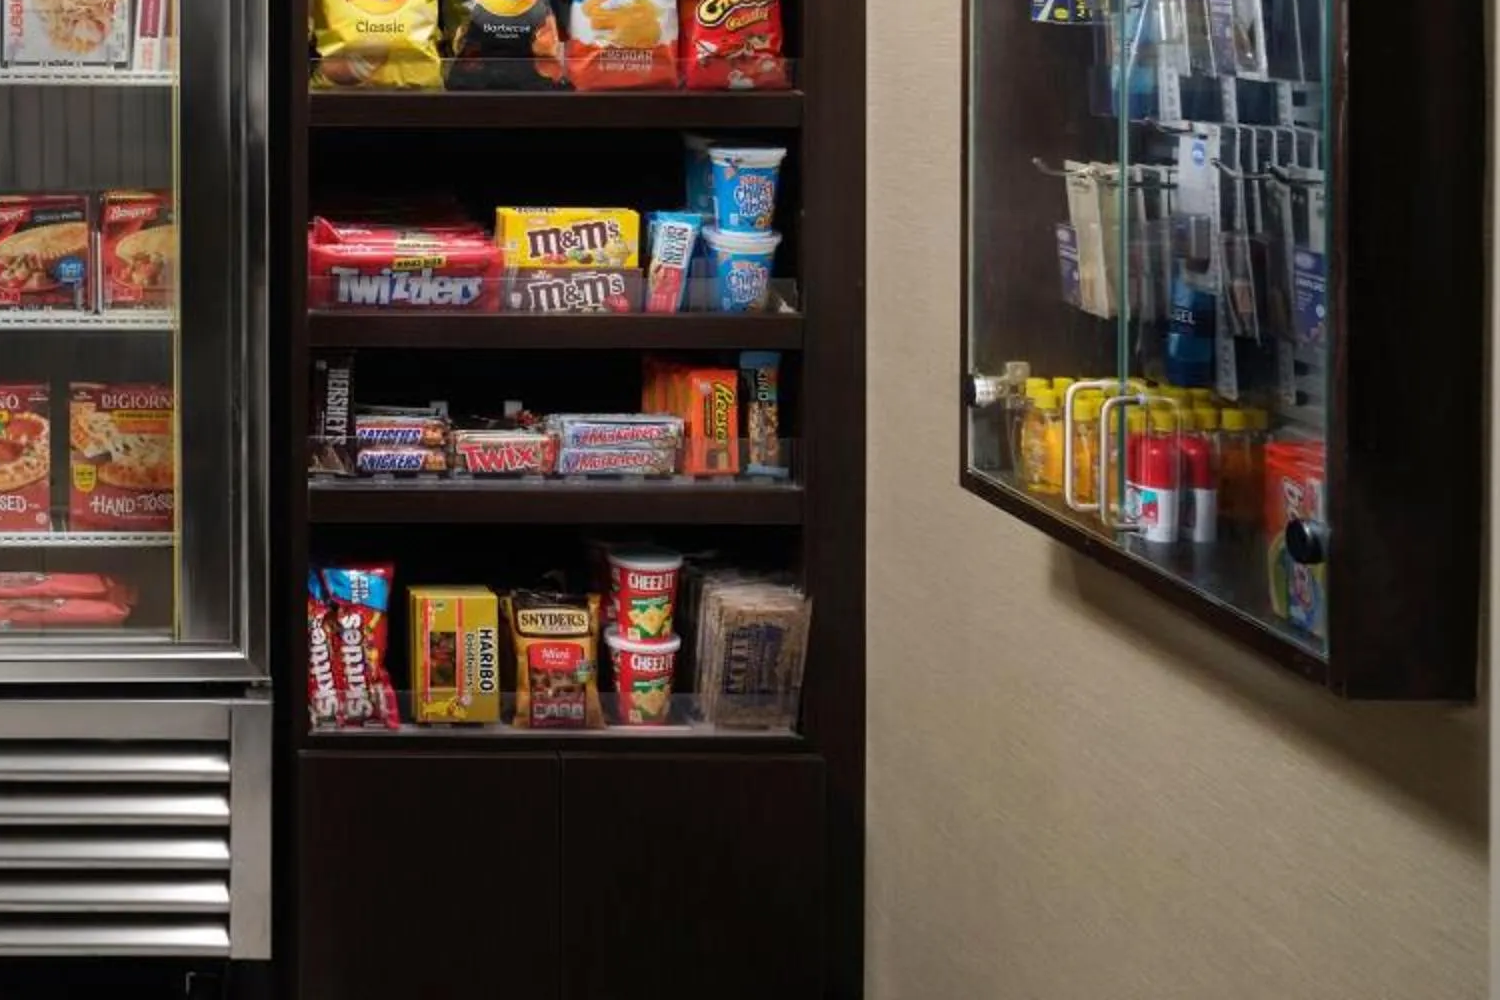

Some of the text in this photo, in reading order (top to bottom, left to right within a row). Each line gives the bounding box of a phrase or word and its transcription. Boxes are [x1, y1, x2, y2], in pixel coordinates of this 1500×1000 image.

[355, 19, 405, 33] Classic
[527, 220, 620, 258] m&m's
[528, 274, 625, 313] m&m's
[101, 394, 174, 409] DIGIORN
[341, 613, 373, 718] Skittles
[479, 629, 495, 693] HARIBO
